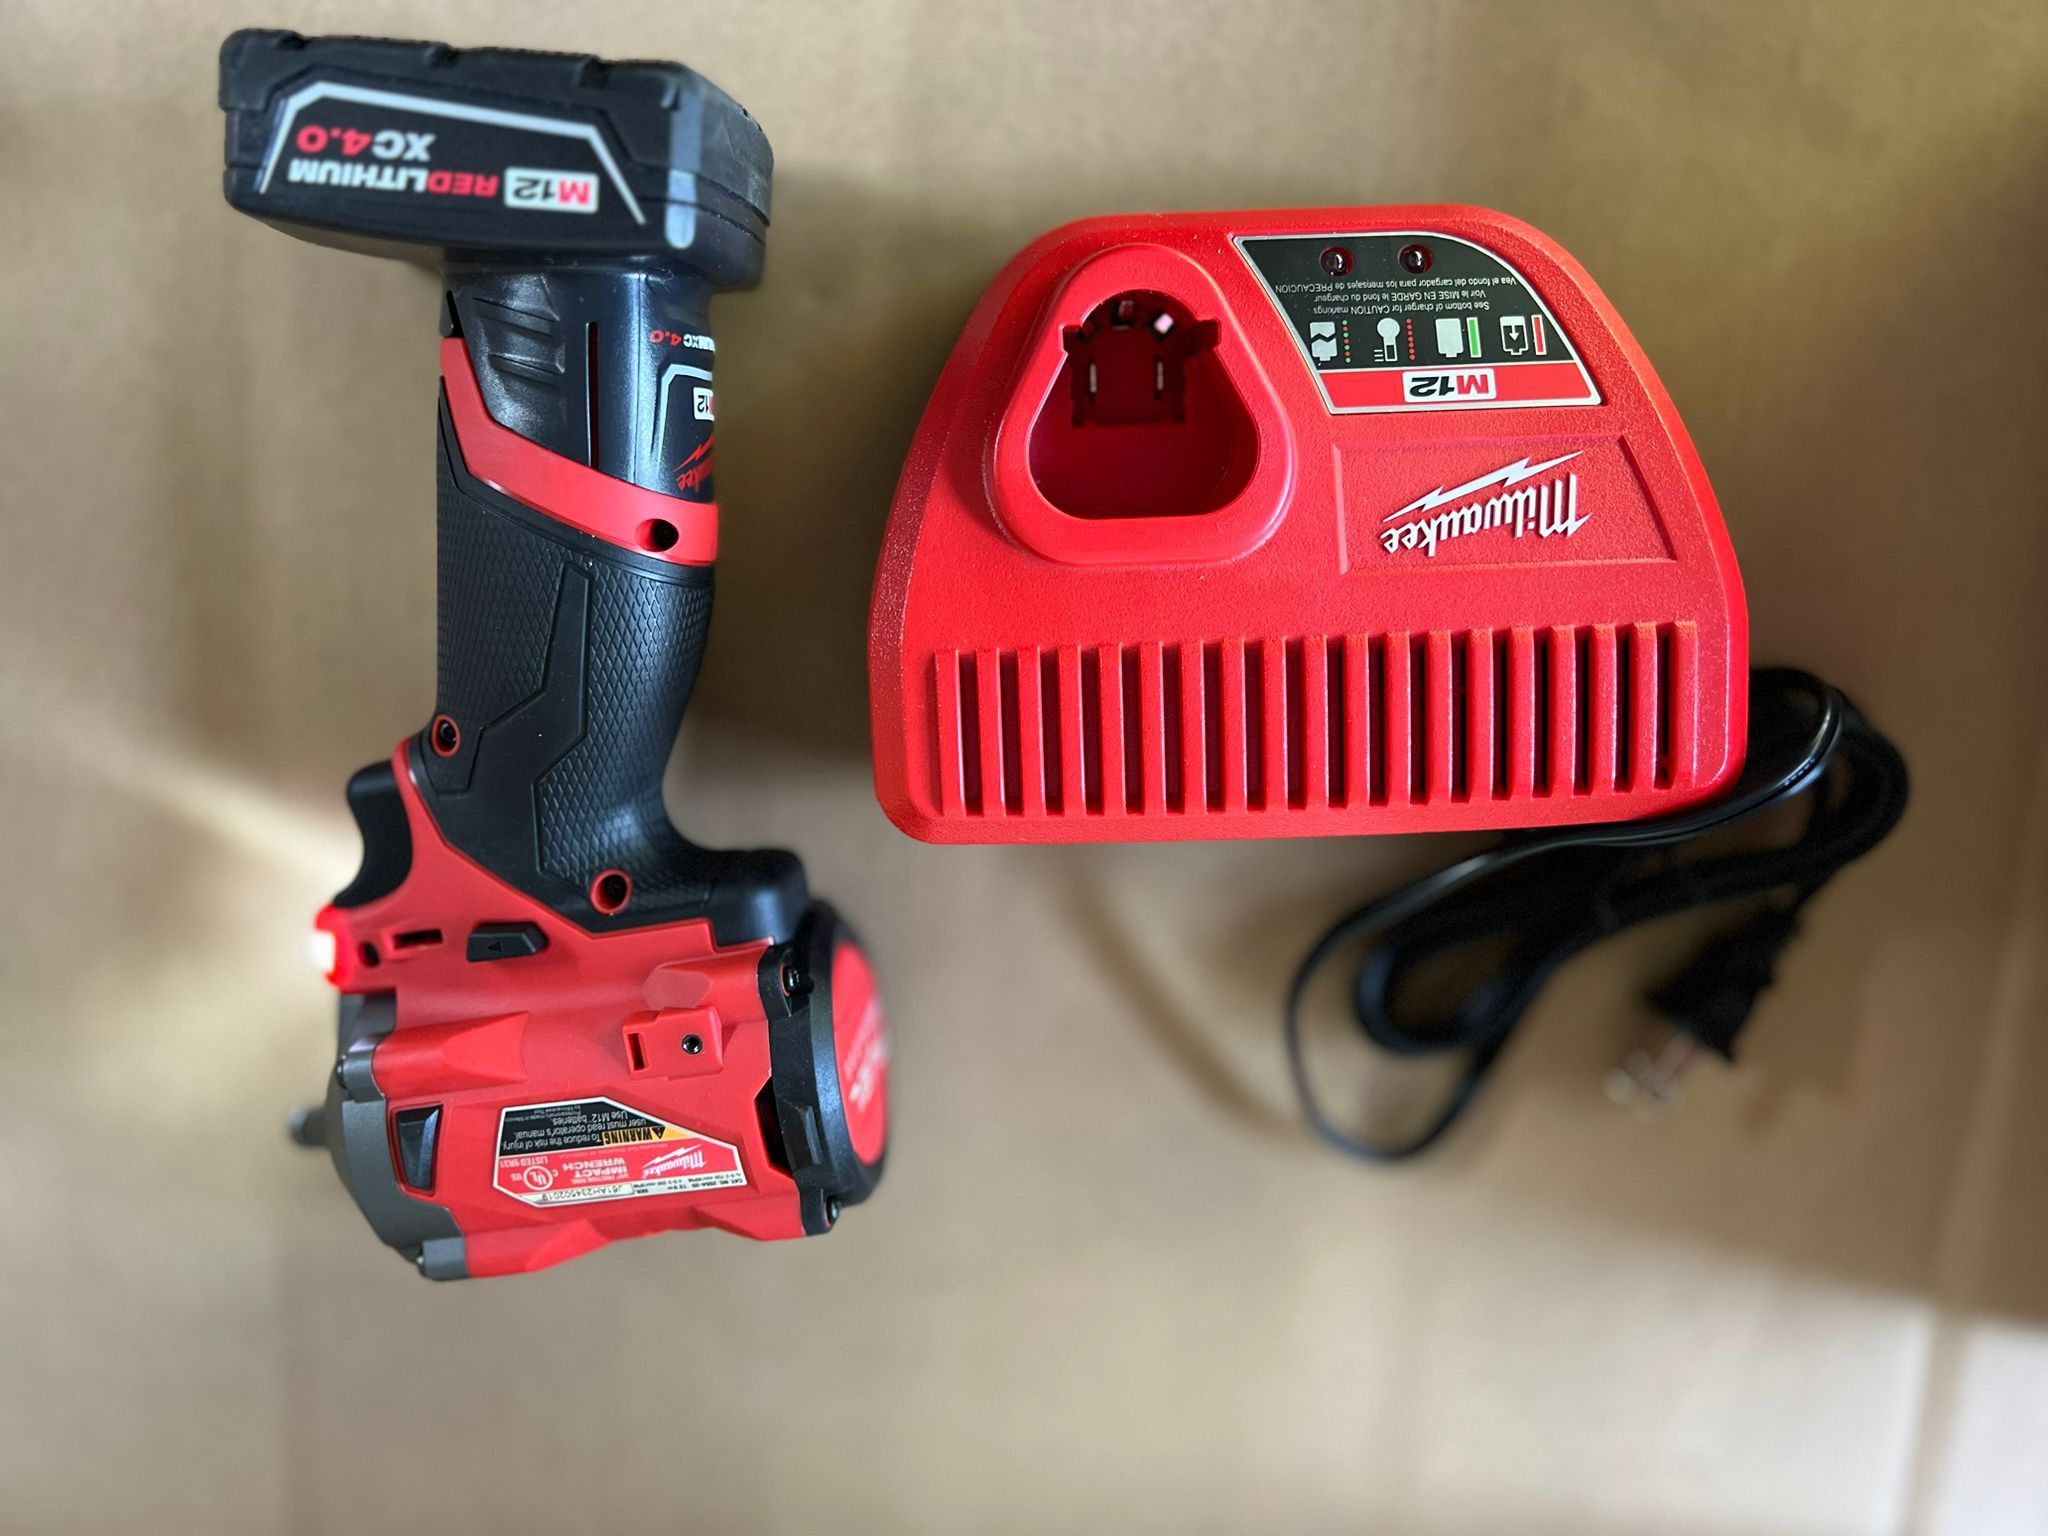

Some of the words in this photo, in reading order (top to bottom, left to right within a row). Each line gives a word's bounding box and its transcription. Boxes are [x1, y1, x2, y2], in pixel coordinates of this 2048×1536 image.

[288, 159, 498, 197] REDLITHIUM
[513, 178, 591, 204] M12
[1347, 280, 1384, 290] mensajes
[1386, 281, 1398, 290] los
[1399, 279, 1417, 288] para
[1419, 278, 1453, 288] cargador
[1454, 278, 1466, 287] del
[1468, 278, 1490, 287] fondo
[1492, 278, 1499, 286] el
[1500, 277, 1516, 286] Vea
[1274, 283, 1333, 293] PRECAUCION
[1335, 283, 1345, 291] de
[1314, 293, 1349, 303] chargeur
[1350, 294, 1361, 302] du
[1362, 293, 1380, 302] fond
[1382, 293, 1389, 301] le
[1391, 292, 1422, 301] GARDE
[1424, 291, 1436, 300] EN
[1438, 290, 1460, 299] MISE
[1462, 290, 1468, 298] le
[1470, 290, 1486, 298] Voir
[1313, 305, 1348, 315] markings
[1350, 305, 1390, 314] CAUTION
[1392, 304, 1402, 314] for
[1404, 302, 1434, 312] charger
[1436, 303, 1444, 312] of
[1445, 302, 1472, 311] bottom
[1474, 302, 1490, 310] See
[1410, 374, 1489, 397] M12
[1380, 473, 1593, 558] Milwaukee
[611, 1111, 628, 1120] Use
[550, 1115, 587, 1126] batteries.
[607, 1121, 627, 1129] must
[629, 1118, 646, 1127] user
[546, 1124, 586, 1136] operator's
[588, 1123, 606, 1132] read
[513, 1130, 545, 1140] manual.
[563, 1134, 590, 1144] reduce
[591, 1134, 601, 1142] To
[605, 1128, 653, 1145] WARNING
[525, 1140, 533, 1150] of
[535, 1139, 548, 1148] risk
[549, 1137, 562, 1146] the
[520, 1156, 548, 1166] LISTED
[562, 1157, 625, 1172] WRENCH
[642, 1150, 708, 1178] Milwaukee
[574, 1165, 627, 1178] IMPACT
[529, 1171, 547, 1185] UL
